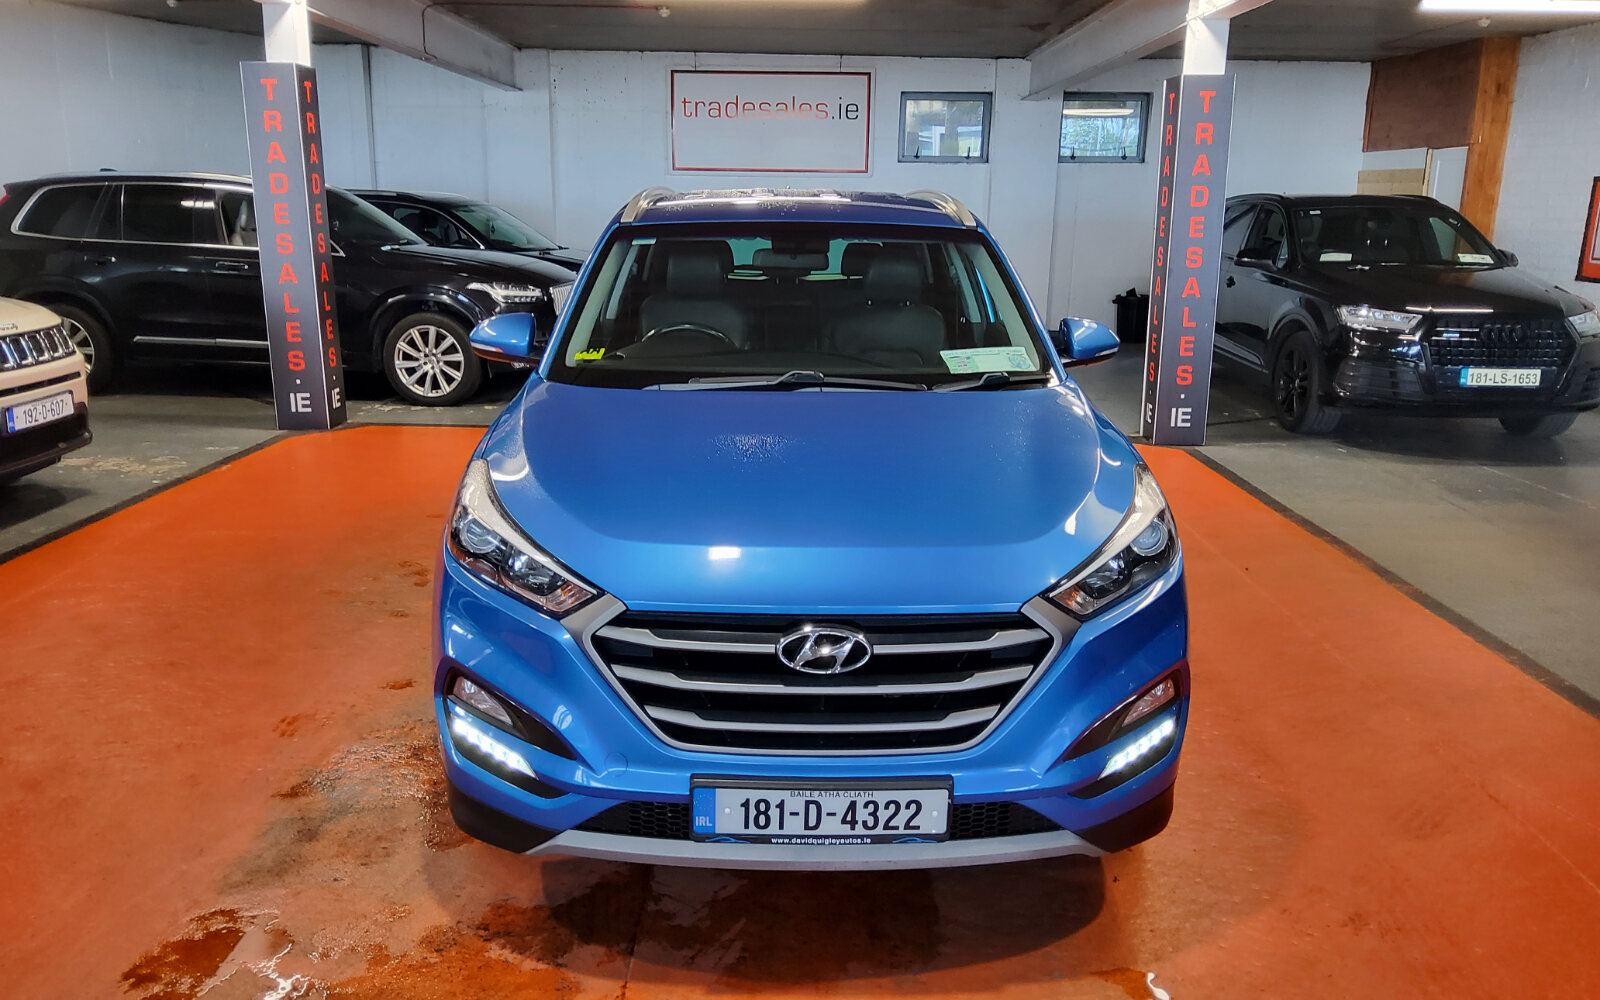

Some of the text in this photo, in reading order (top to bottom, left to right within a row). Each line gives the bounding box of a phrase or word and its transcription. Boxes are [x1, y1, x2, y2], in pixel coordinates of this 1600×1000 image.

[681, 95, 859, 120] tradesales.ie
[1469, 372, 1538, 385] 181-LS-1653
[22, 399, 64, 425] 192-D-607
[695, 816, 713, 827] IRL
[739, 797, 923, 831] 181-D-4322
[771, 836, 872, 845] www.davidquigleyautos.ie
